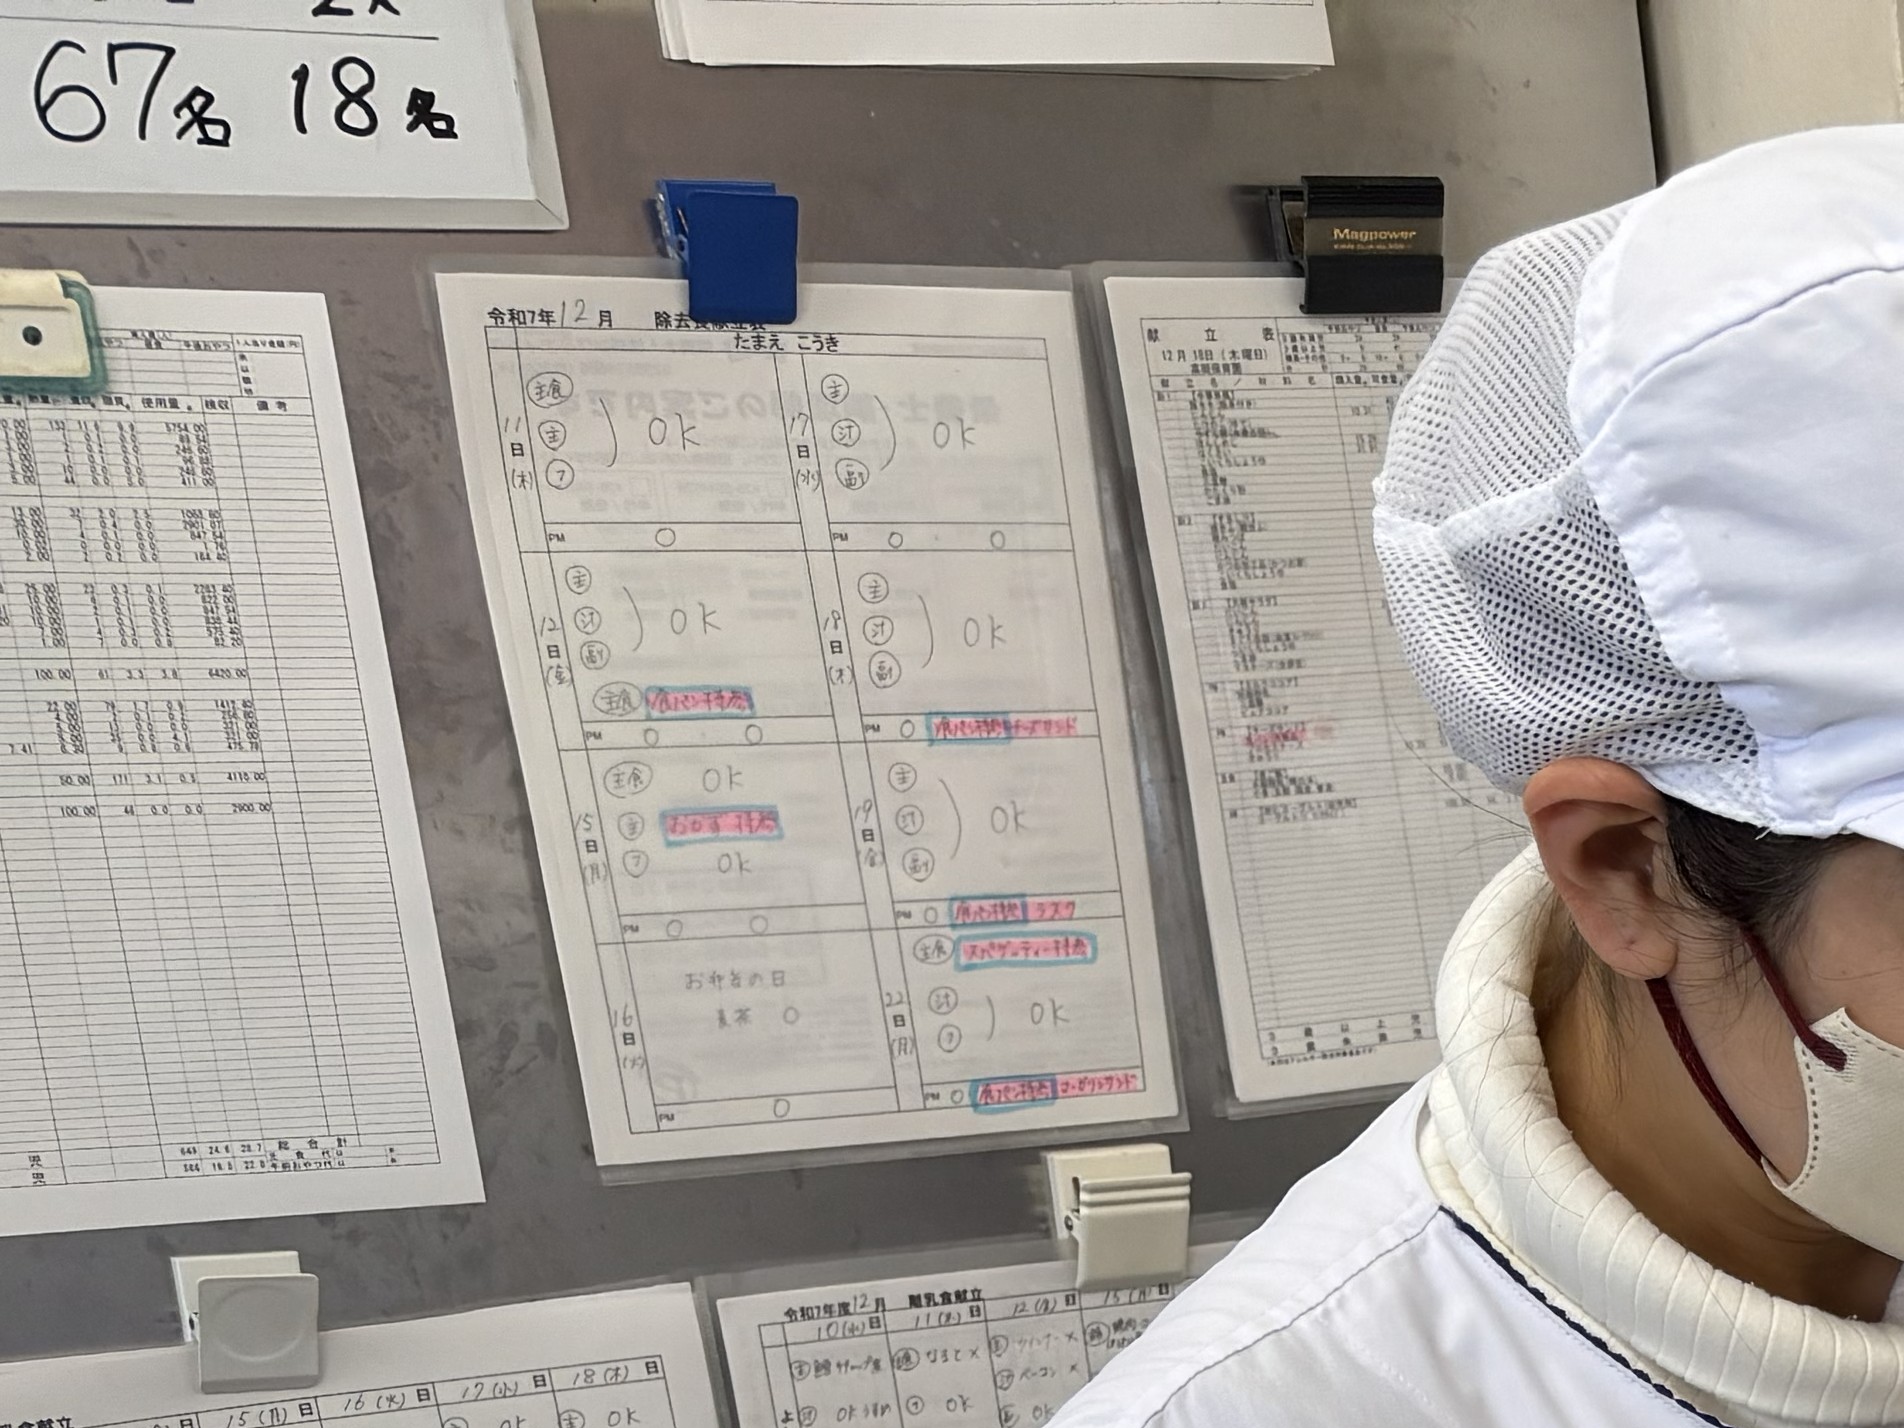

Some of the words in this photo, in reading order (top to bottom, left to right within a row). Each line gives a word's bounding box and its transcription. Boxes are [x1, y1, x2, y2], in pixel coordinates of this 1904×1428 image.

[33, 40, 230, 147] 67名
[292, 56, 458, 139] 18名
[1334, 228, 1417, 242] Magpower
[734, 333, 784, 350] たまえ
[797, 333, 839, 352] こうき
